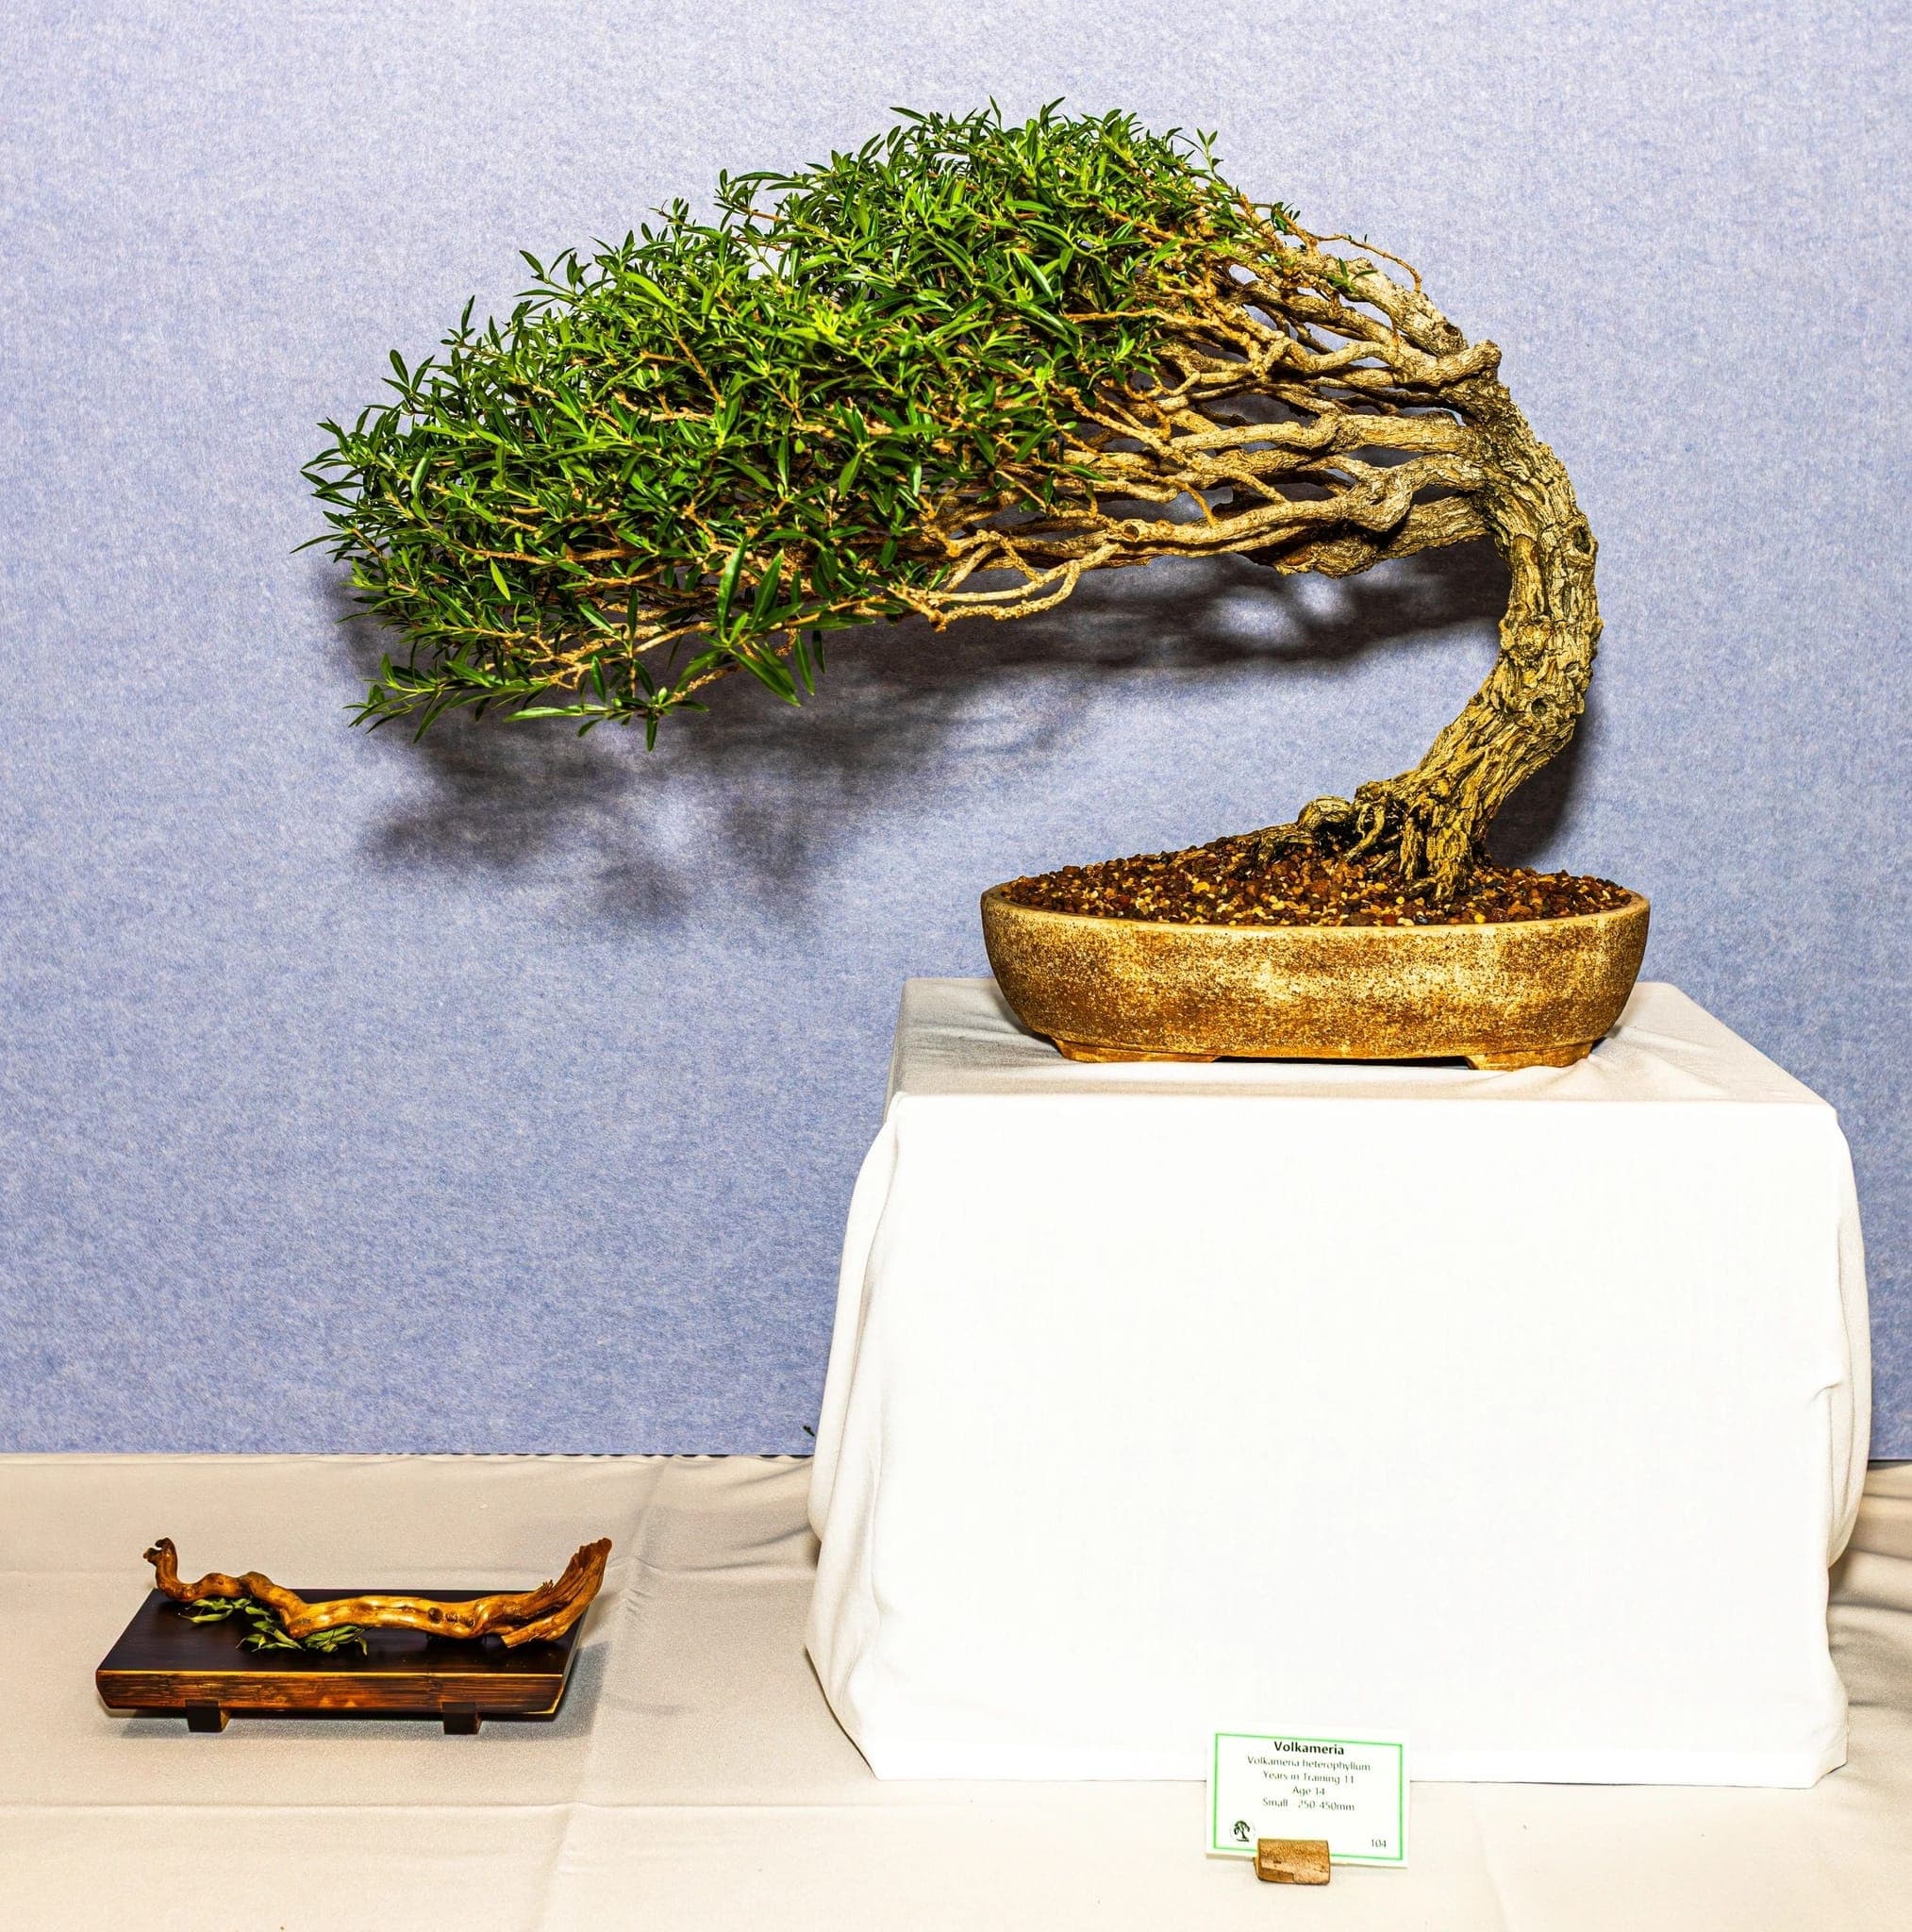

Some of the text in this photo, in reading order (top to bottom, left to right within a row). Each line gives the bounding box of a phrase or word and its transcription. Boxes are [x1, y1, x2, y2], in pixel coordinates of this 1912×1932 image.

[1273, 1740, 1344, 1756] Volkameria
[1247, 1756, 1371, 1771] Volkameria heterophyllum
[1262, 1771, 1288, 1780] Years
[1303, 1772, 1340, 1785] Training
[1344, 1774, 1354, 1784] 11
[1292, 1786, 1325, 1796] Age 14
[1262, 1798, 1289, 1807] Small
[1371, 1839, 1387, 1848] 104
